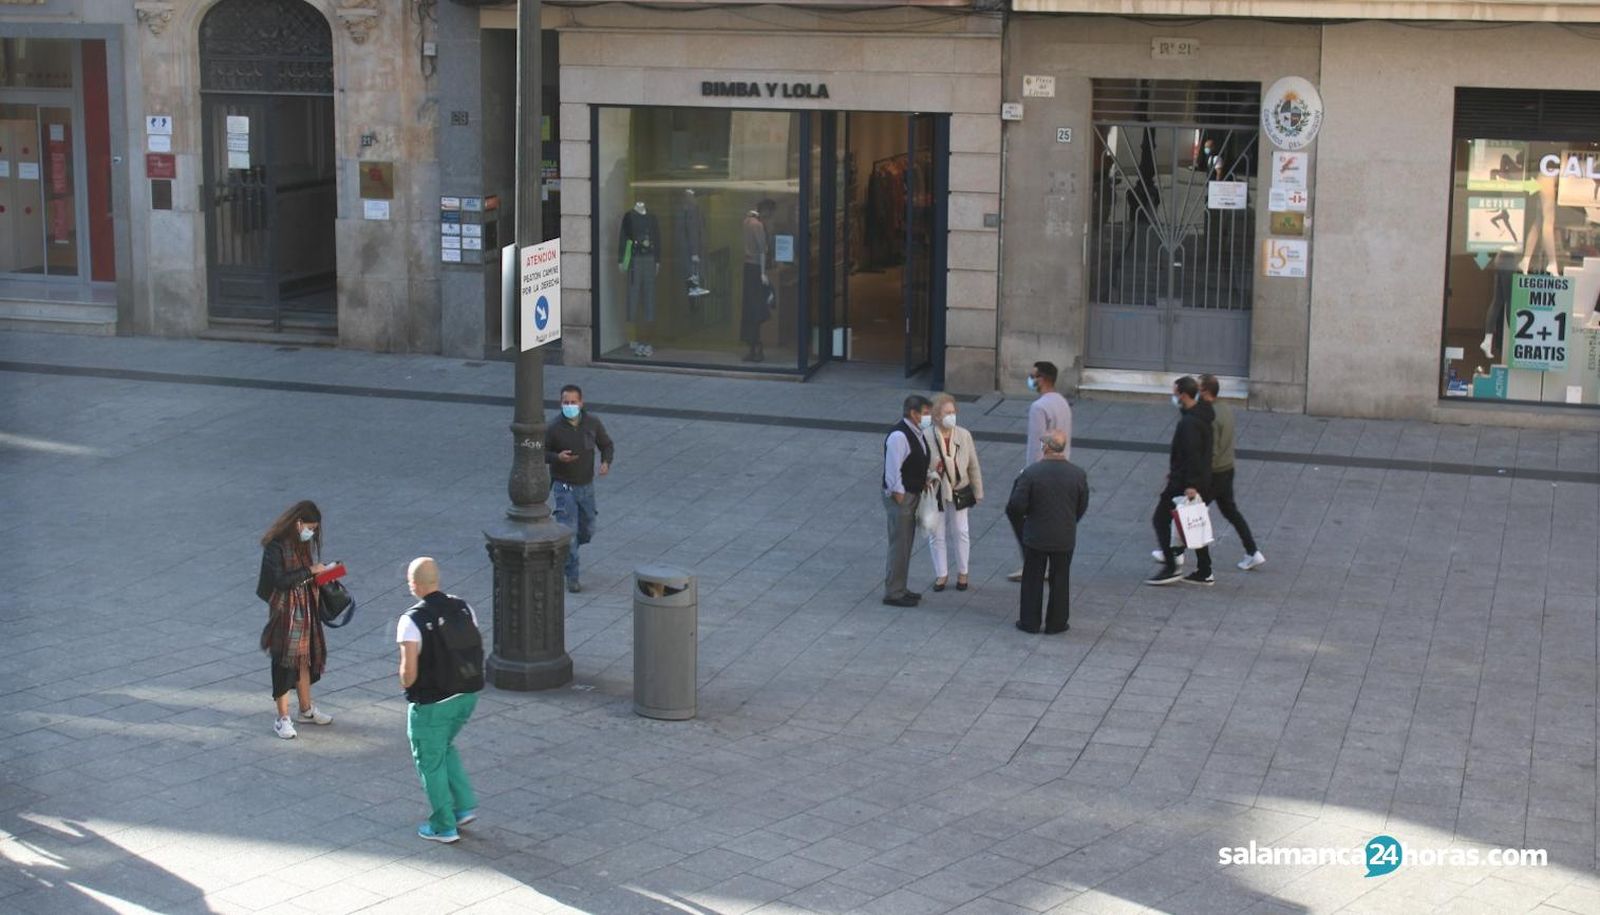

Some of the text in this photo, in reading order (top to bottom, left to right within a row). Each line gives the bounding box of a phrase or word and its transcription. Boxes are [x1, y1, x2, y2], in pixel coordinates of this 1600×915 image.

[702, 81, 829, 99] BIMBA Y LOLA
[1058, 129, 1070, 141] 25
[1539, 153, 1600, 179] CAL
[1480, 199, 1515, 208] ACTIVE
[524, 265, 558, 283] PEATON CAMINE
[522, 278, 559, 295] POR LA DERECHA
[1519, 278, 1568, 290] LEGGINGS
[1529, 291, 1556, 306] MIX
[1514, 309, 1567, 342] 2+1
[1514, 344, 1565, 362] GRATIS
